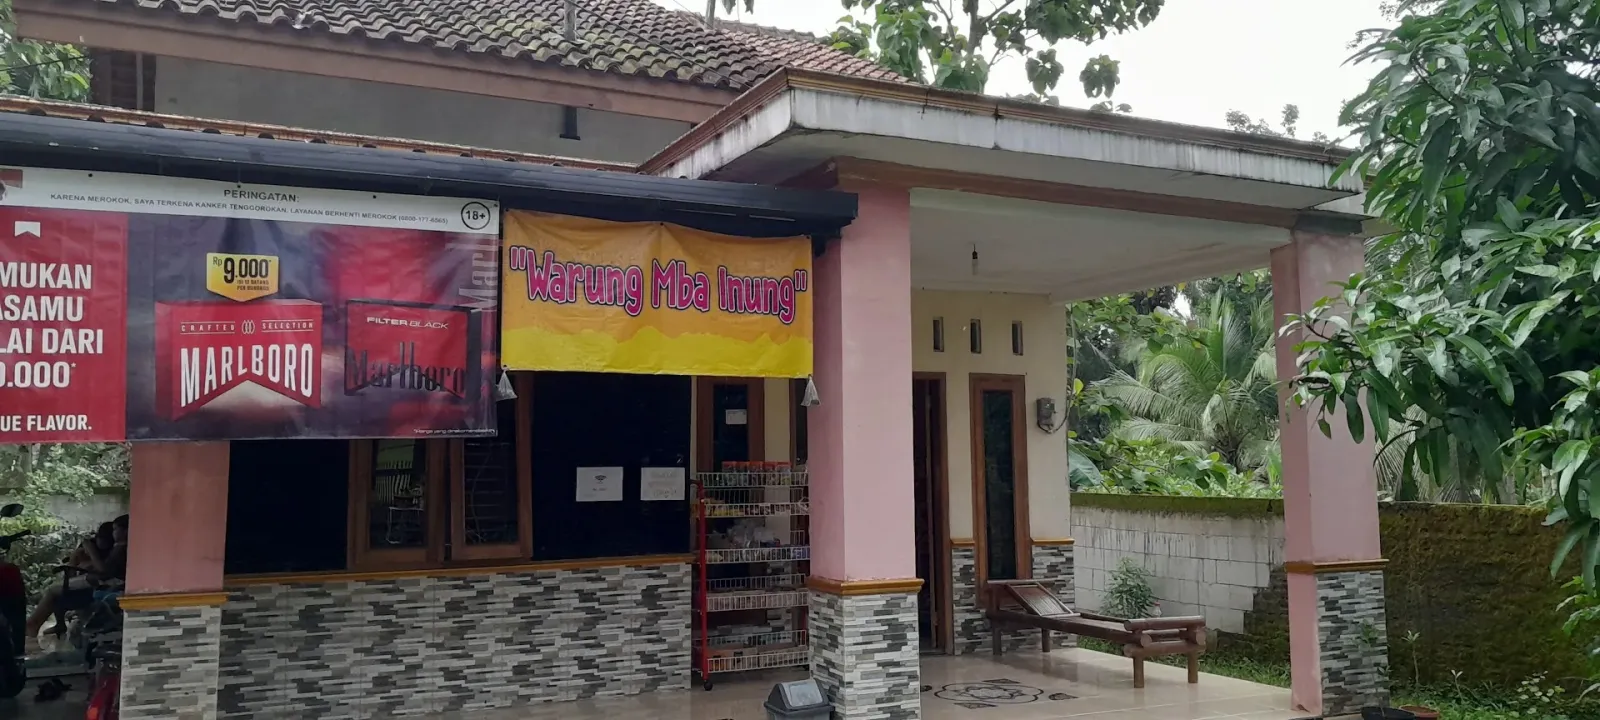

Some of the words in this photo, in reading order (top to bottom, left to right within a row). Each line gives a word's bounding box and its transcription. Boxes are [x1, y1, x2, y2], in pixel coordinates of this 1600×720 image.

[224, 189, 300, 203] PERINGATAN:
[157, 200, 194, 208] TERKENA
[290, 208, 324, 216] LAYANAN
[325, 210, 360, 218] BERHENTI
[465, 210, 486, 220] 18+
[213, 257, 222, 266] Rp
[510, 246, 644, 317] "Warung
[651, 258, 711, 312] Mba
[717, 265, 808, 325] Inung"
[0, 294, 84, 322] SAMU
[181, 323, 235, 332] CRAFTED
[262, 321, 314, 329] SELECTION
[366, 316, 408, 326] FILTER
[409, 320, 449, 329] BLACK
[42, 328, 104, 354] DARI
[344, 341, 466, 392] Marlboro
[180, 343, 313, 408] MARLBORO
[27, 414, 92, 431] FLAVOR.
